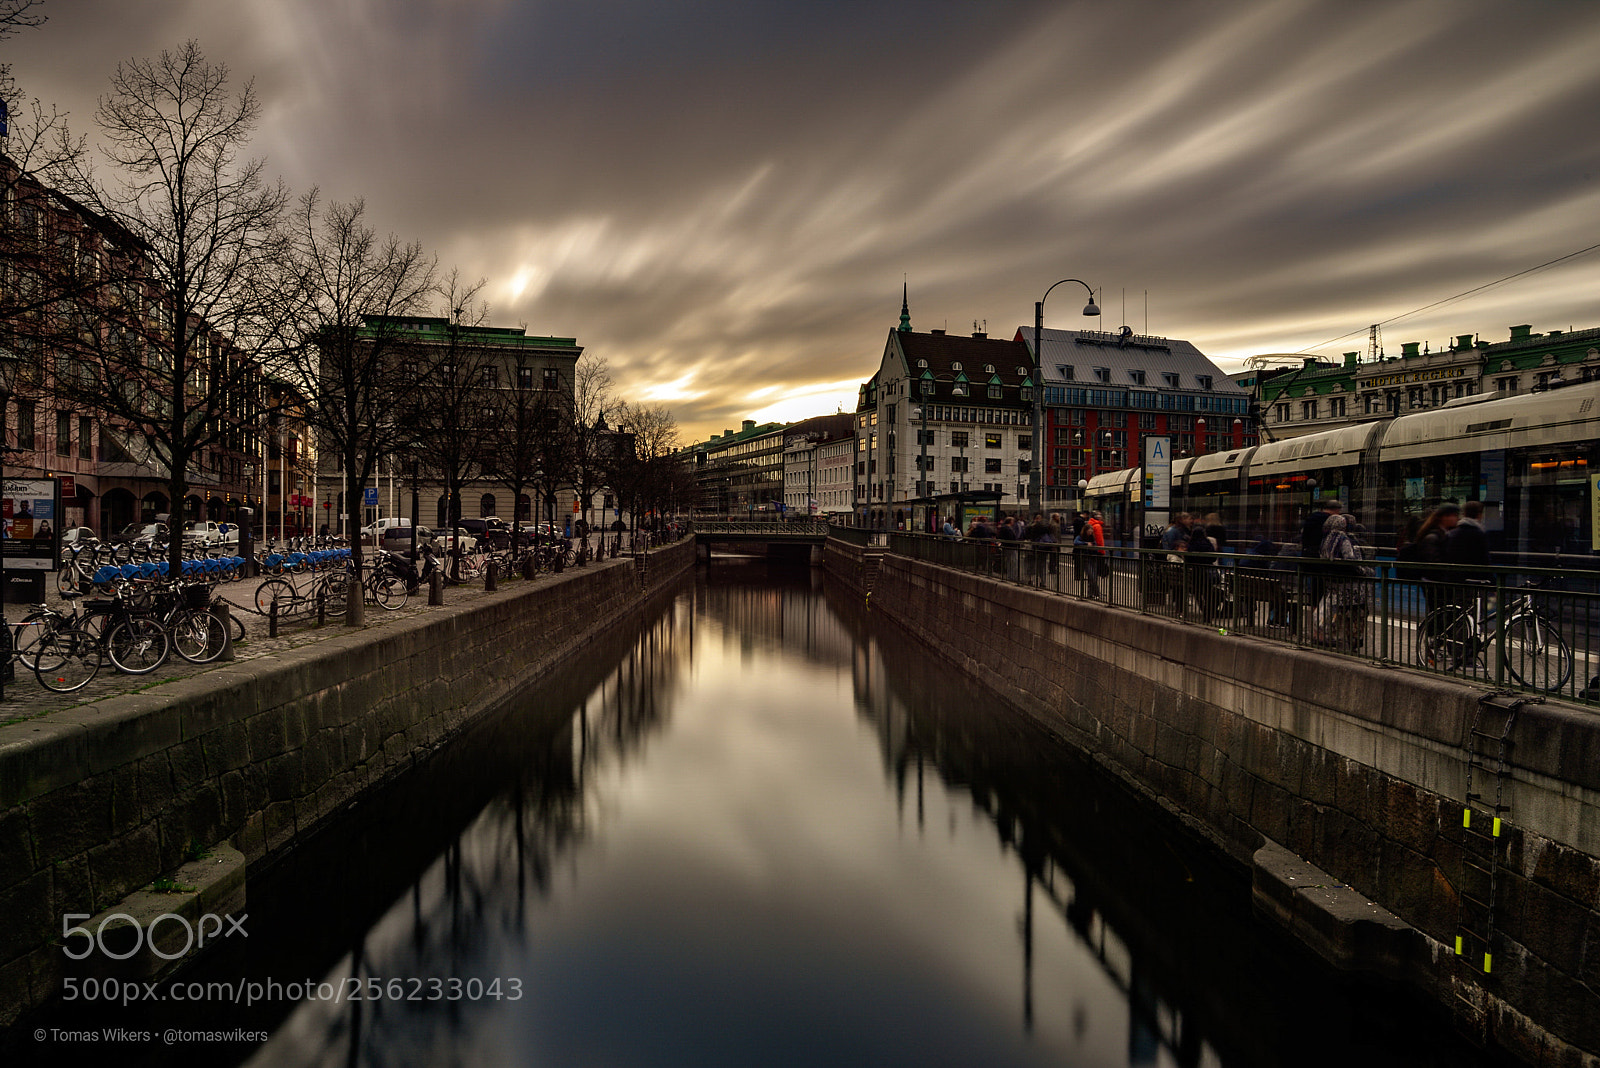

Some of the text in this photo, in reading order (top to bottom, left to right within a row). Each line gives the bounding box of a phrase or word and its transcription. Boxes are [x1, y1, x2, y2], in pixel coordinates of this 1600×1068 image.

[1080, 329, 1168, 346] HOTEL OPERA
[1369, 367, 1462, 388] HOTEL EGGERS
[1152, 440, 1164, 459] A
[368, 488, 375, 498] P
